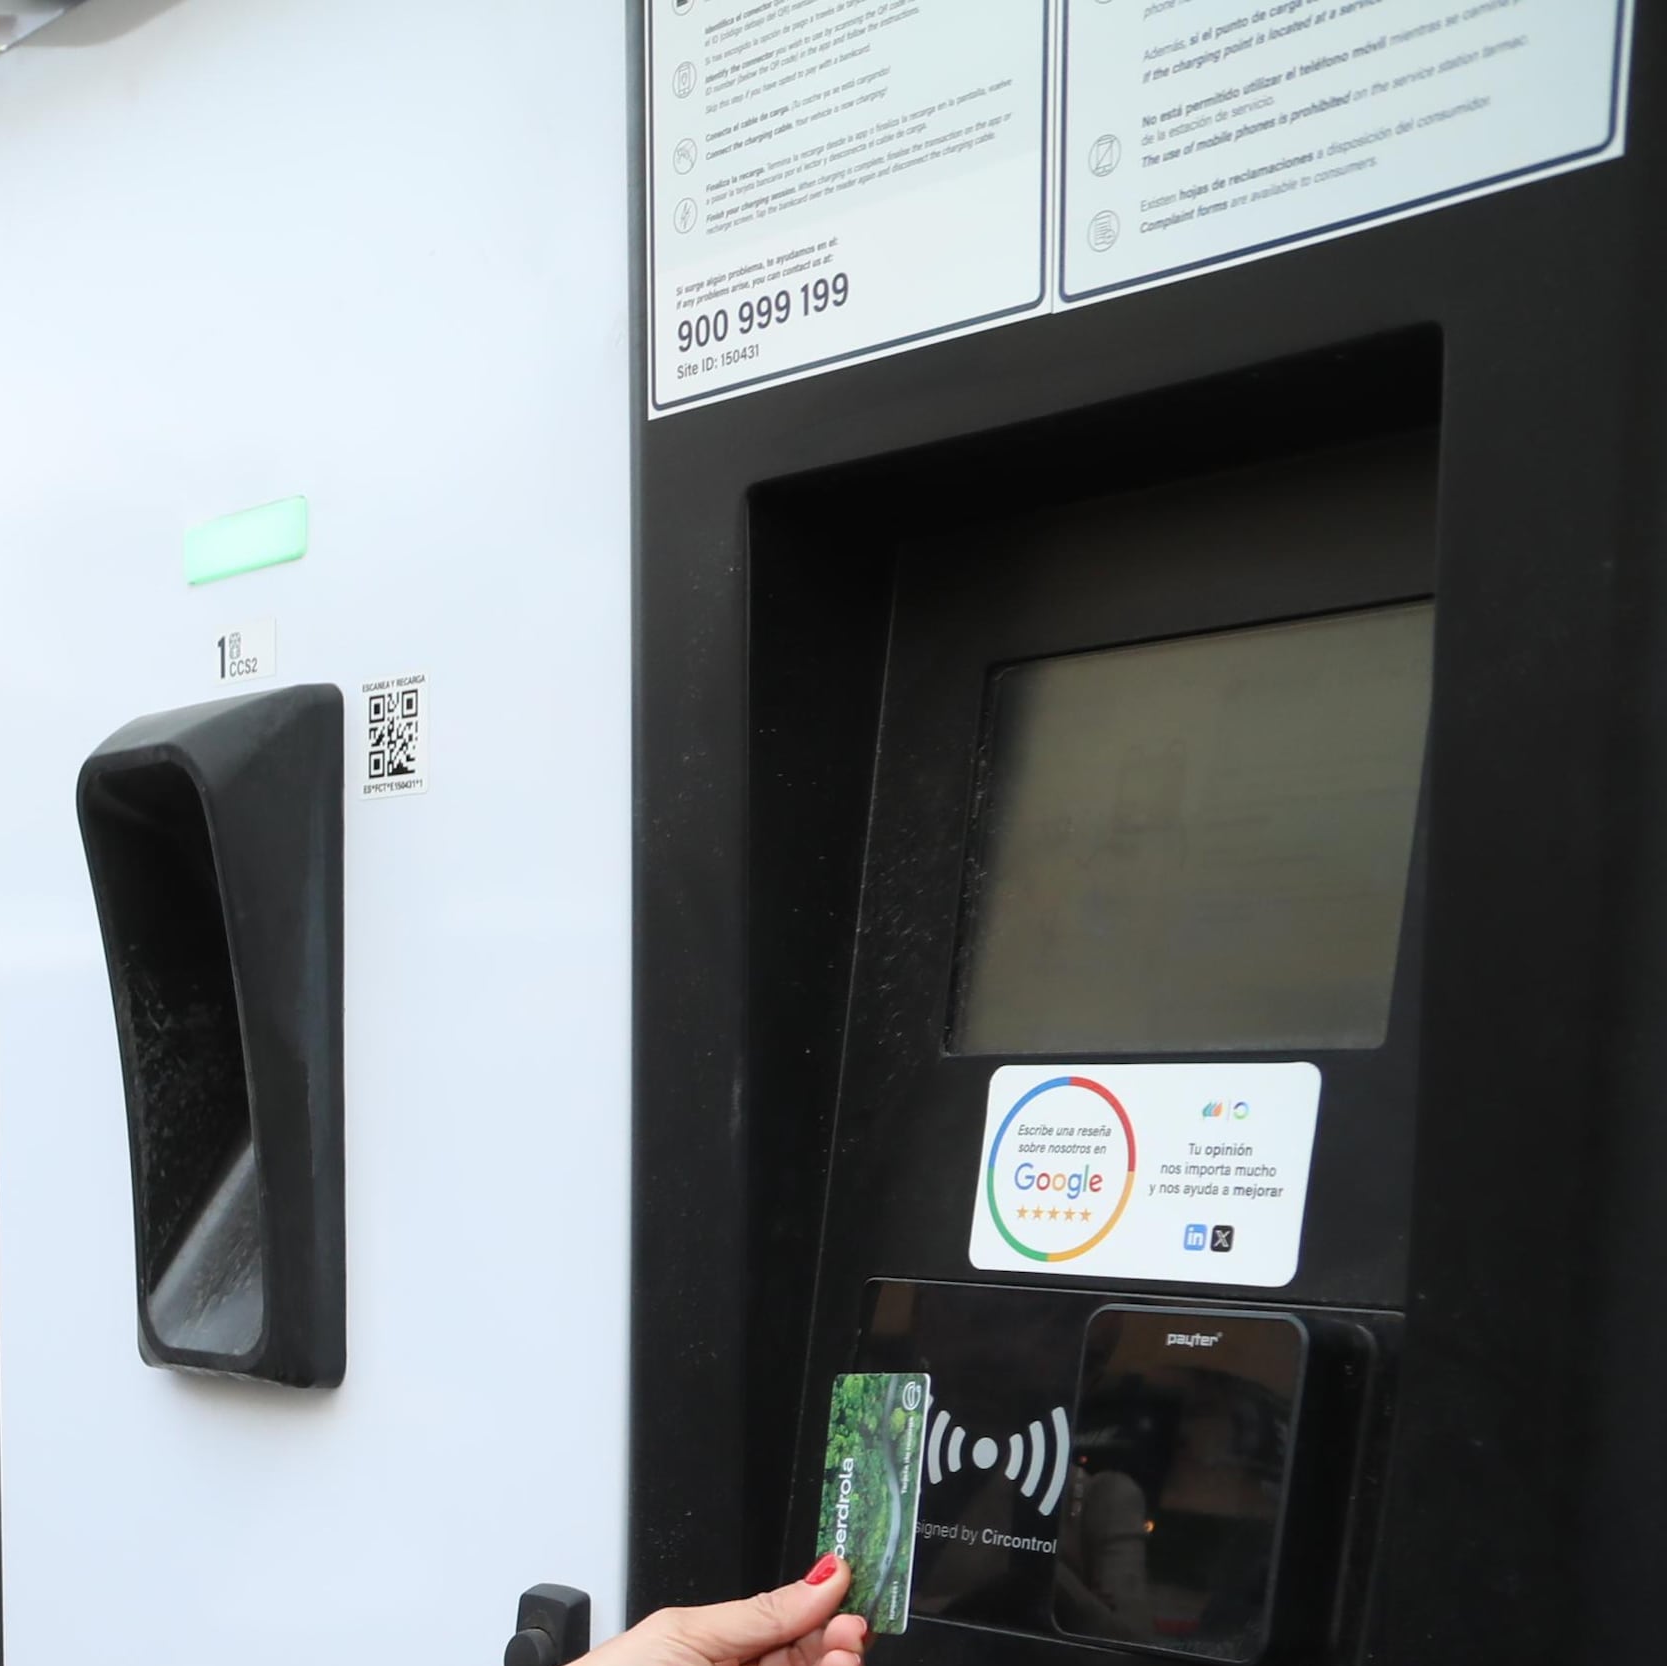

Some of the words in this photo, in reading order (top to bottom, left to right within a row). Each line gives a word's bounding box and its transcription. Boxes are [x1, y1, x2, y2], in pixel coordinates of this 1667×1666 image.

[678, 309, 728, 353] 900
[738, 290, 791, 334] 999
[800, 272, 849, 316] 199
[677, 363, 699, 379] Site
[702, 356, 718, 373] ID:
[721, 344, 759, 367] 150431
[218, 636, 226, 679] 1
[229, 657, 258, 678] CCS2
[362, 680, 389, 693] ESCANEA
[396, 674, 426, 687] RECARGA
[1018, 1124, 1054, 1136] Escribe
[1056, 1126, 1075, 1137] una
[1076, 1125, 1112, 1137] reseña
[1018, 1142, 1046, 1153] sobre
[1047, 1143, 1092, 1154] nosotros
[1093, 1145, 1107, 1155] en
[1188, 1142, 1202, 1155] Tu
[1204, 1142, 1253, 1158] opinión
[1014, 1162, 1103, 1200] Google
[1160, 1163, 1182, 1175] nos
[1184, 1161, 1231, 1178] importa
[1234, 1163, 1277, 1177] mucho
[1149, 1183, 1156, 1196] y
[1159, 1183, 1180, 1194] nos
[1183, 1182, 1219, 1198] ayuda
[1222, 1186, 1230, 1196] a
[1233, 1183, 1284, 1200] mejorar
[833, 1457, 855, 1560] berdrola
[915, 1520, 959, 1539] signed
[961, 1525, 979, 1546] by
[981, 1528, 1057, 1554] Circontrol
